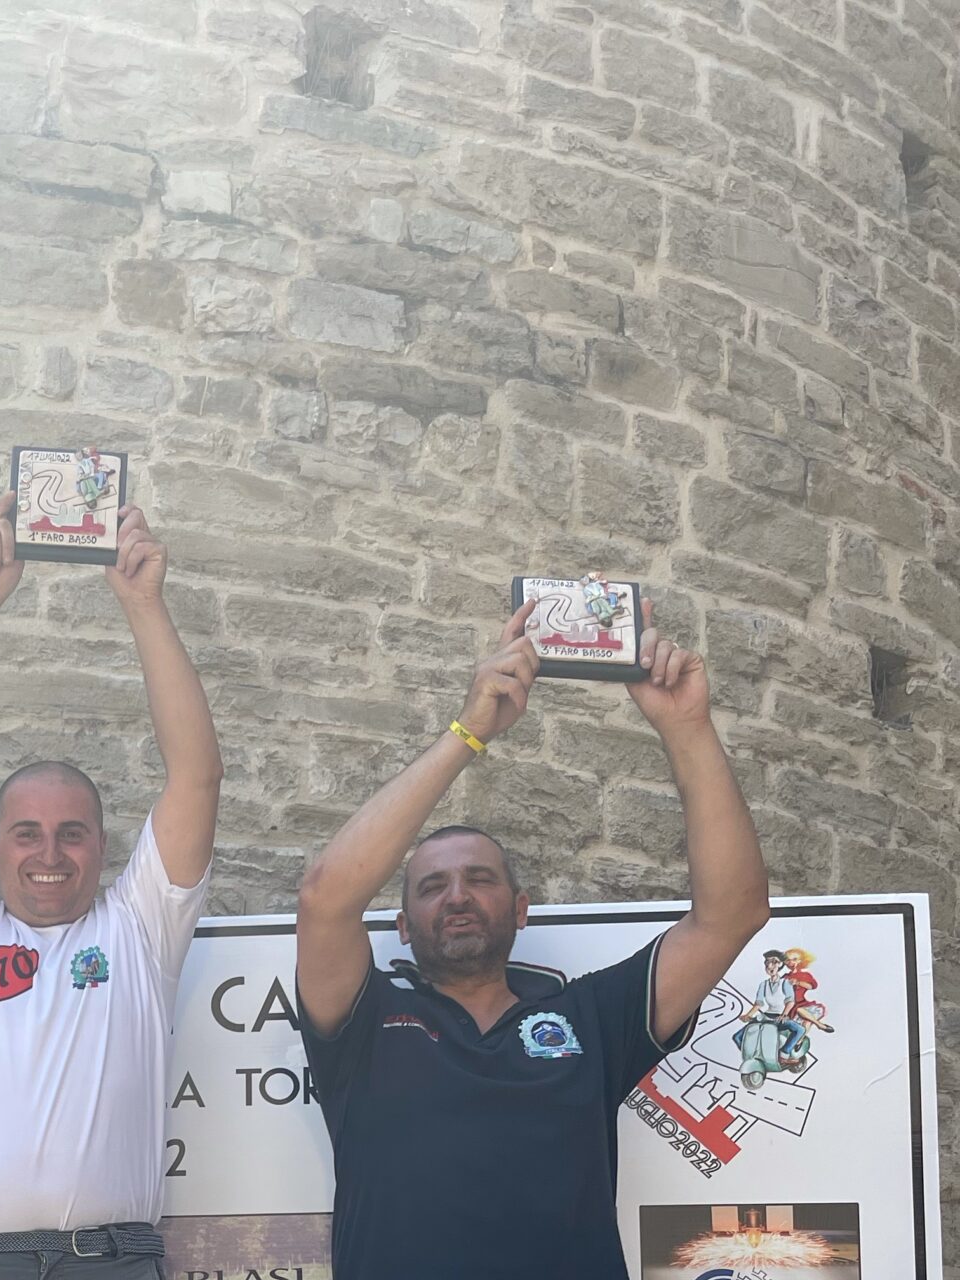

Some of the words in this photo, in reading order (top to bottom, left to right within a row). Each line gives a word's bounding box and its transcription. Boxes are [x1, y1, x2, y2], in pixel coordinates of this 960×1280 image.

[41, 532, 64, 542] FARO
[68, 535, 97, 544] BASSO
[555, 647, 578, 655] FARO
[583, 650, 613, 658] BASSO
